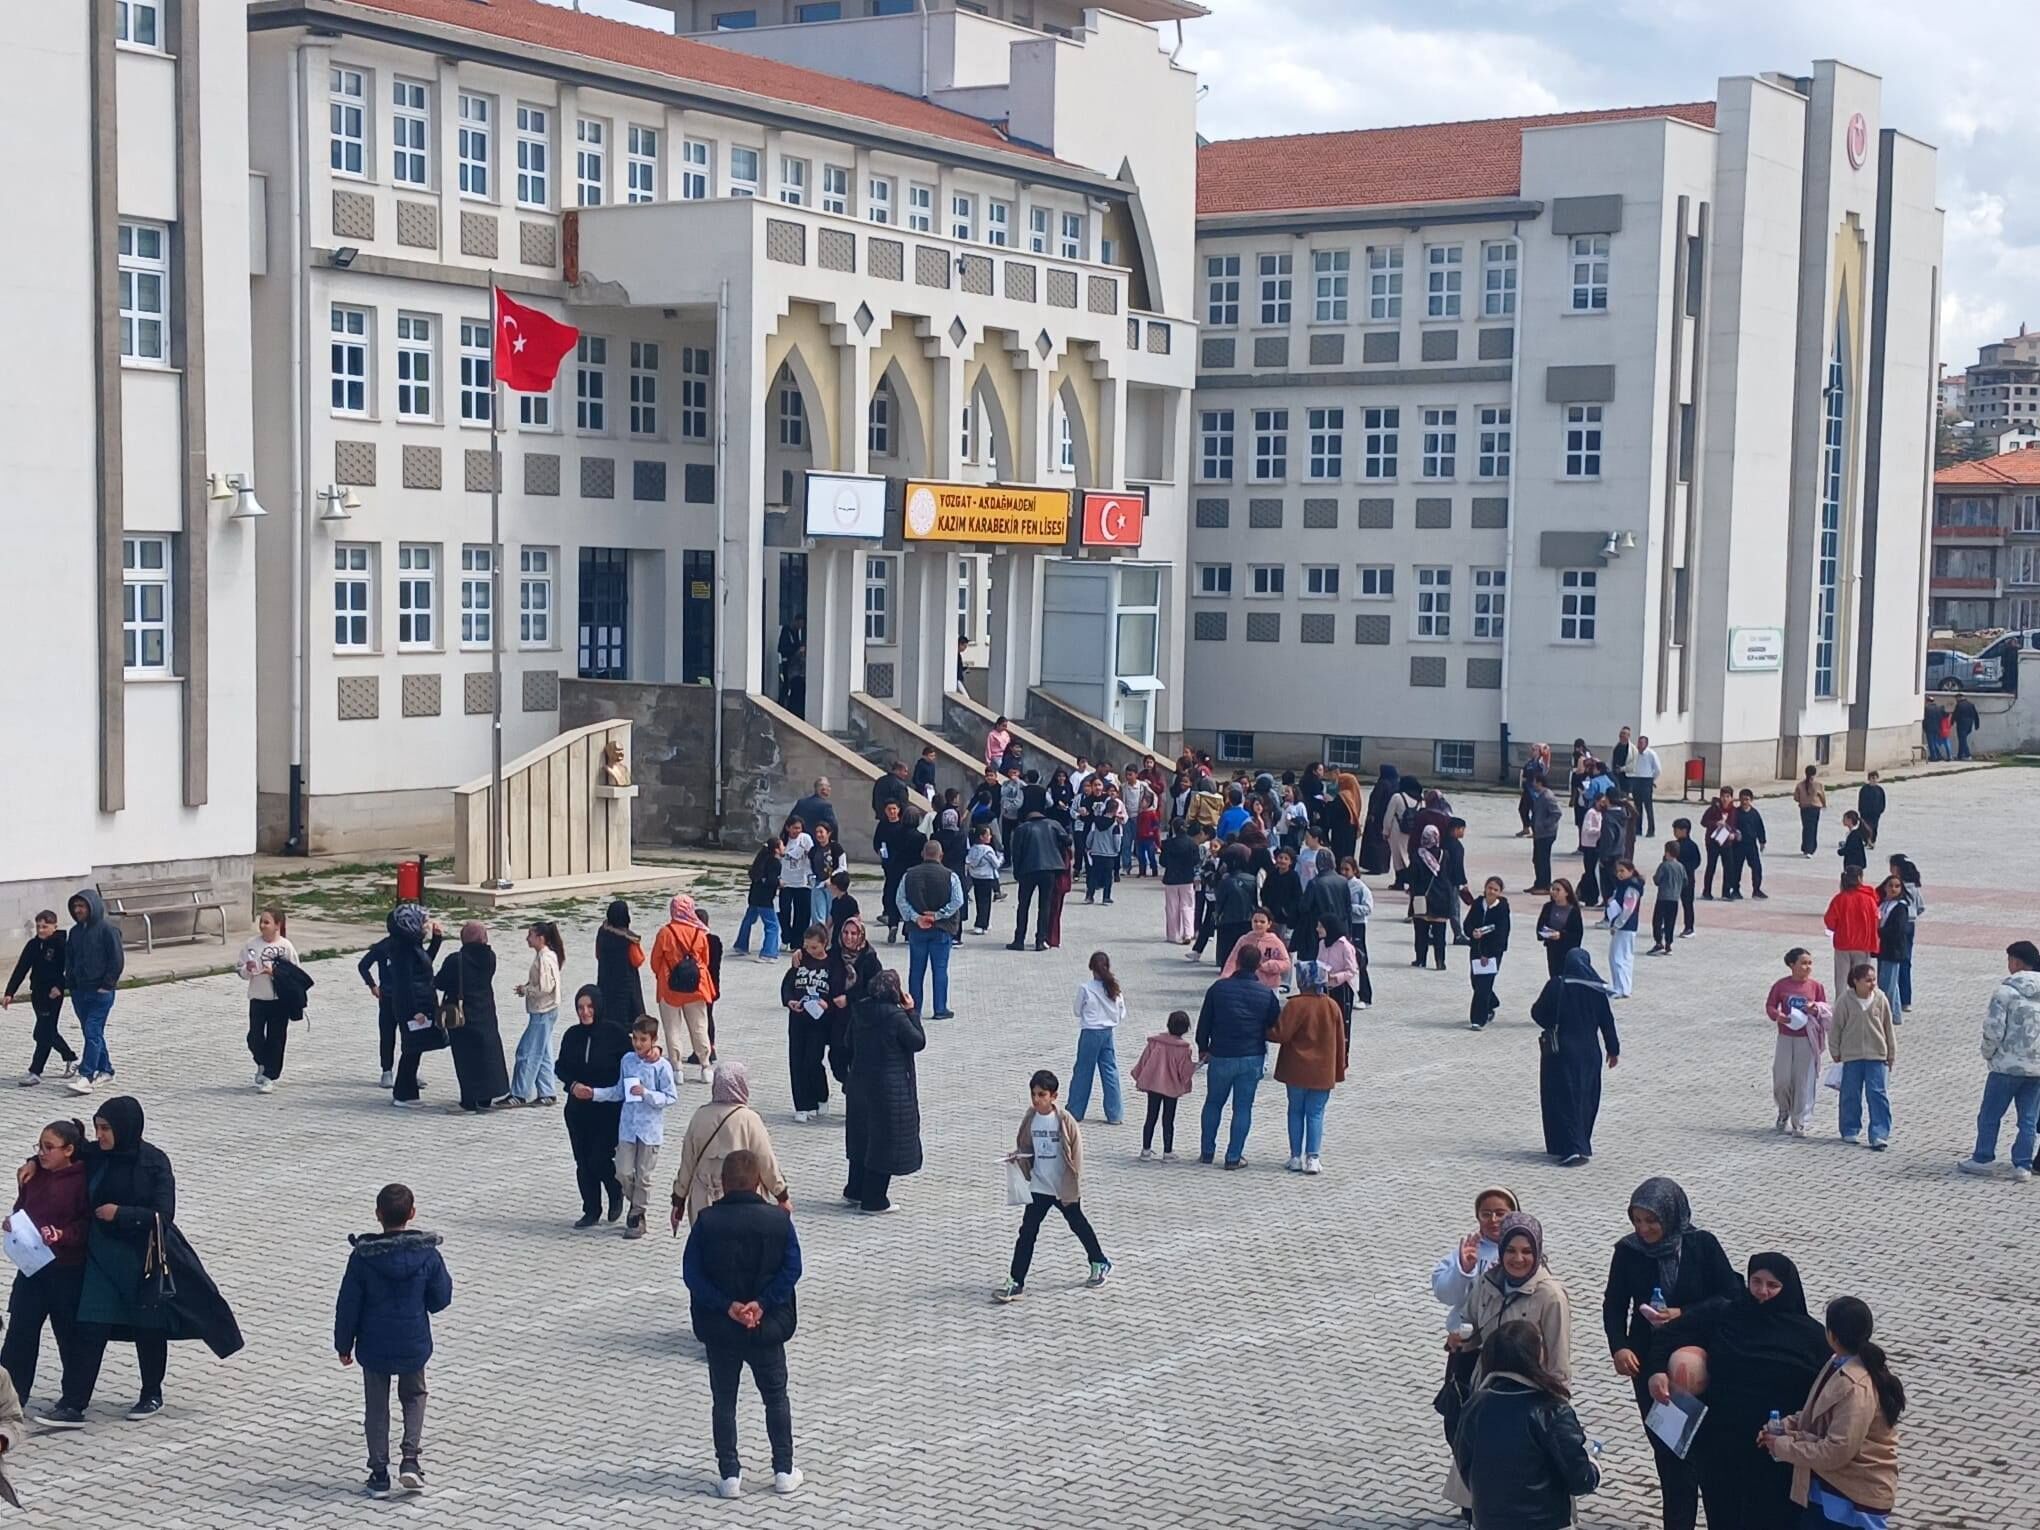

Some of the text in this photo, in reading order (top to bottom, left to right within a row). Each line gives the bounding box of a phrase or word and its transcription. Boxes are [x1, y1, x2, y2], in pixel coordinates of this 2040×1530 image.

[940, 494, 972, 508] YOZGAT
[978, 495, 1037, 512] AKDAĞMADENİ
[938, 515, 1065, 536] KAZIM KARABEKİR FEN LİSESİ
